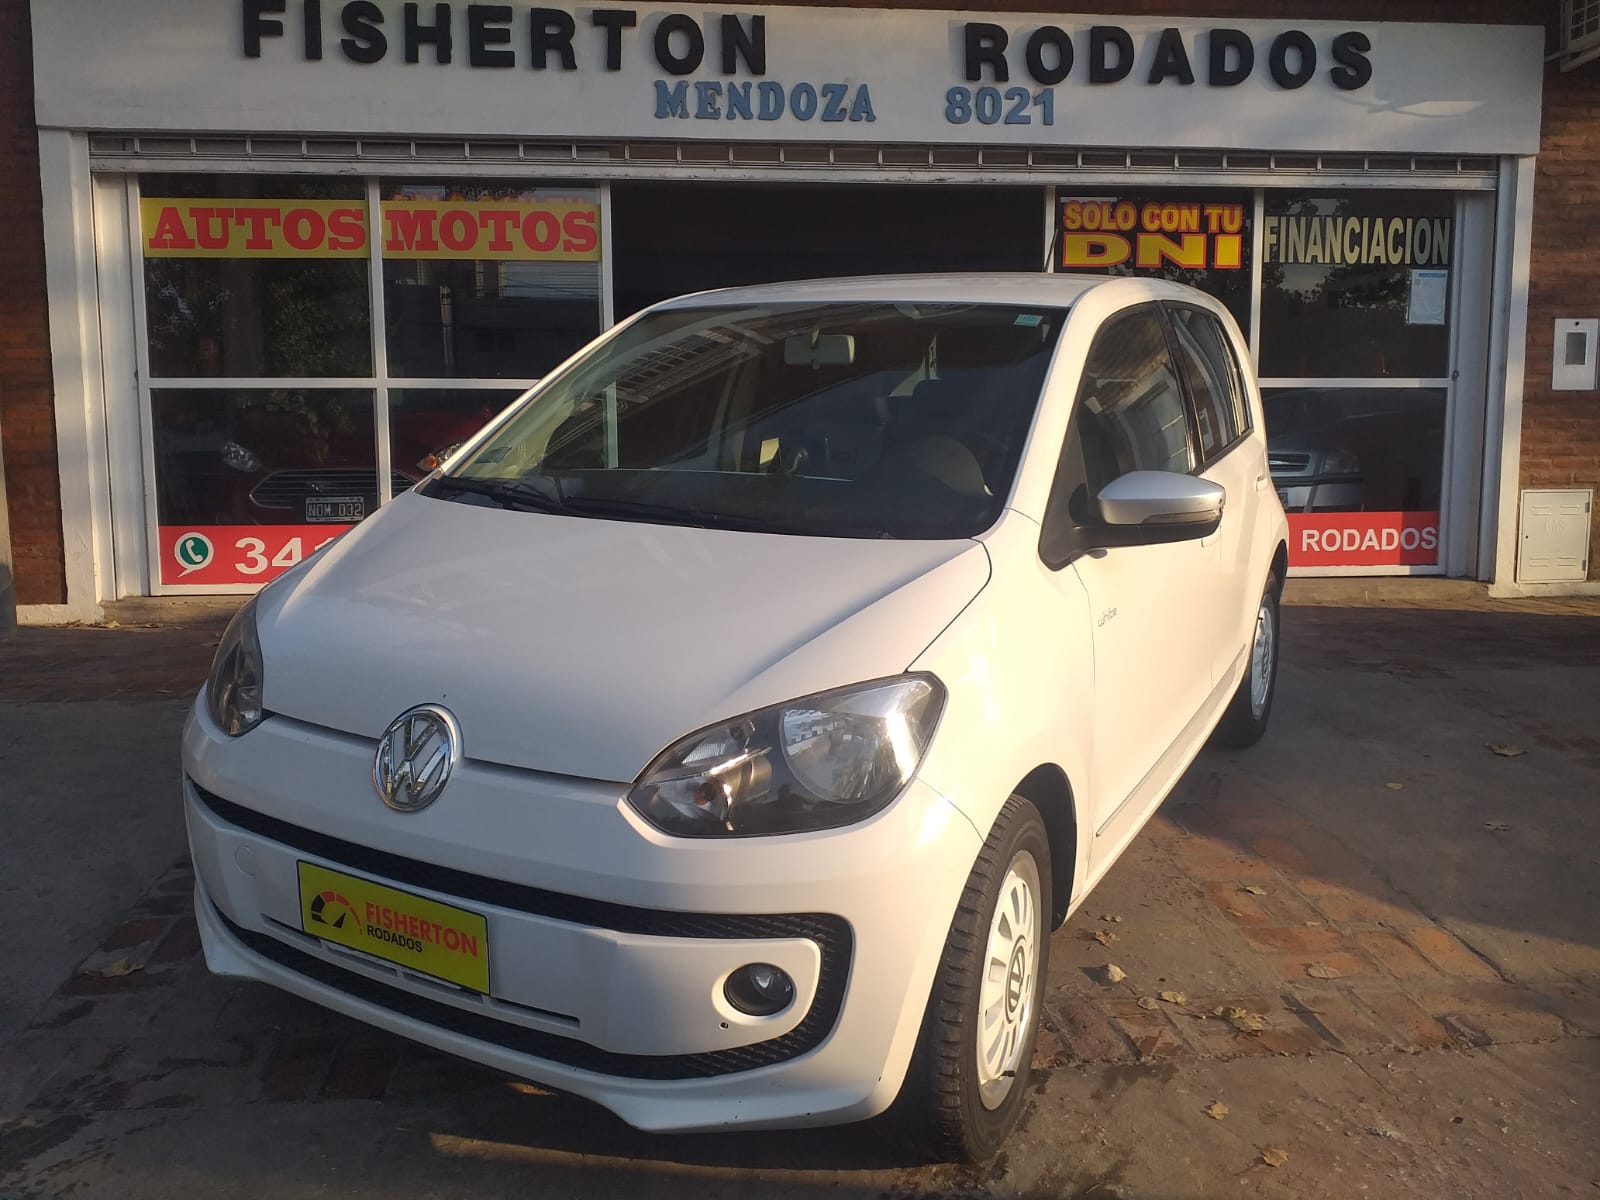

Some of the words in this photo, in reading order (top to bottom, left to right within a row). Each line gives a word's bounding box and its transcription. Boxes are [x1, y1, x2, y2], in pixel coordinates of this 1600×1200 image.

[243, 0, 766, 75] FISHERTON
[965, 22, 1373, 90] RODADOS
[654, 80, 877, 123] MENDOZA
[945, 86, 1055, 126] 8021
[148, 206, 367, 251] AUTOS
[384, 209, 598, 252] MOTOS
[1063, 200, 1137, 232] SOLO
[1141, 203, 1200, 233] CON
[1204, 204, 1243, 234] TU
[1062, 231, 1243, 270] DNI
[1263, 215, 1452, 265] FINANCIACION
[1301, 526, 1438, 552] RODADOS
[364, 901, 479, 957] FISHERTON
[366, 924, 423, 953] RODADOS
